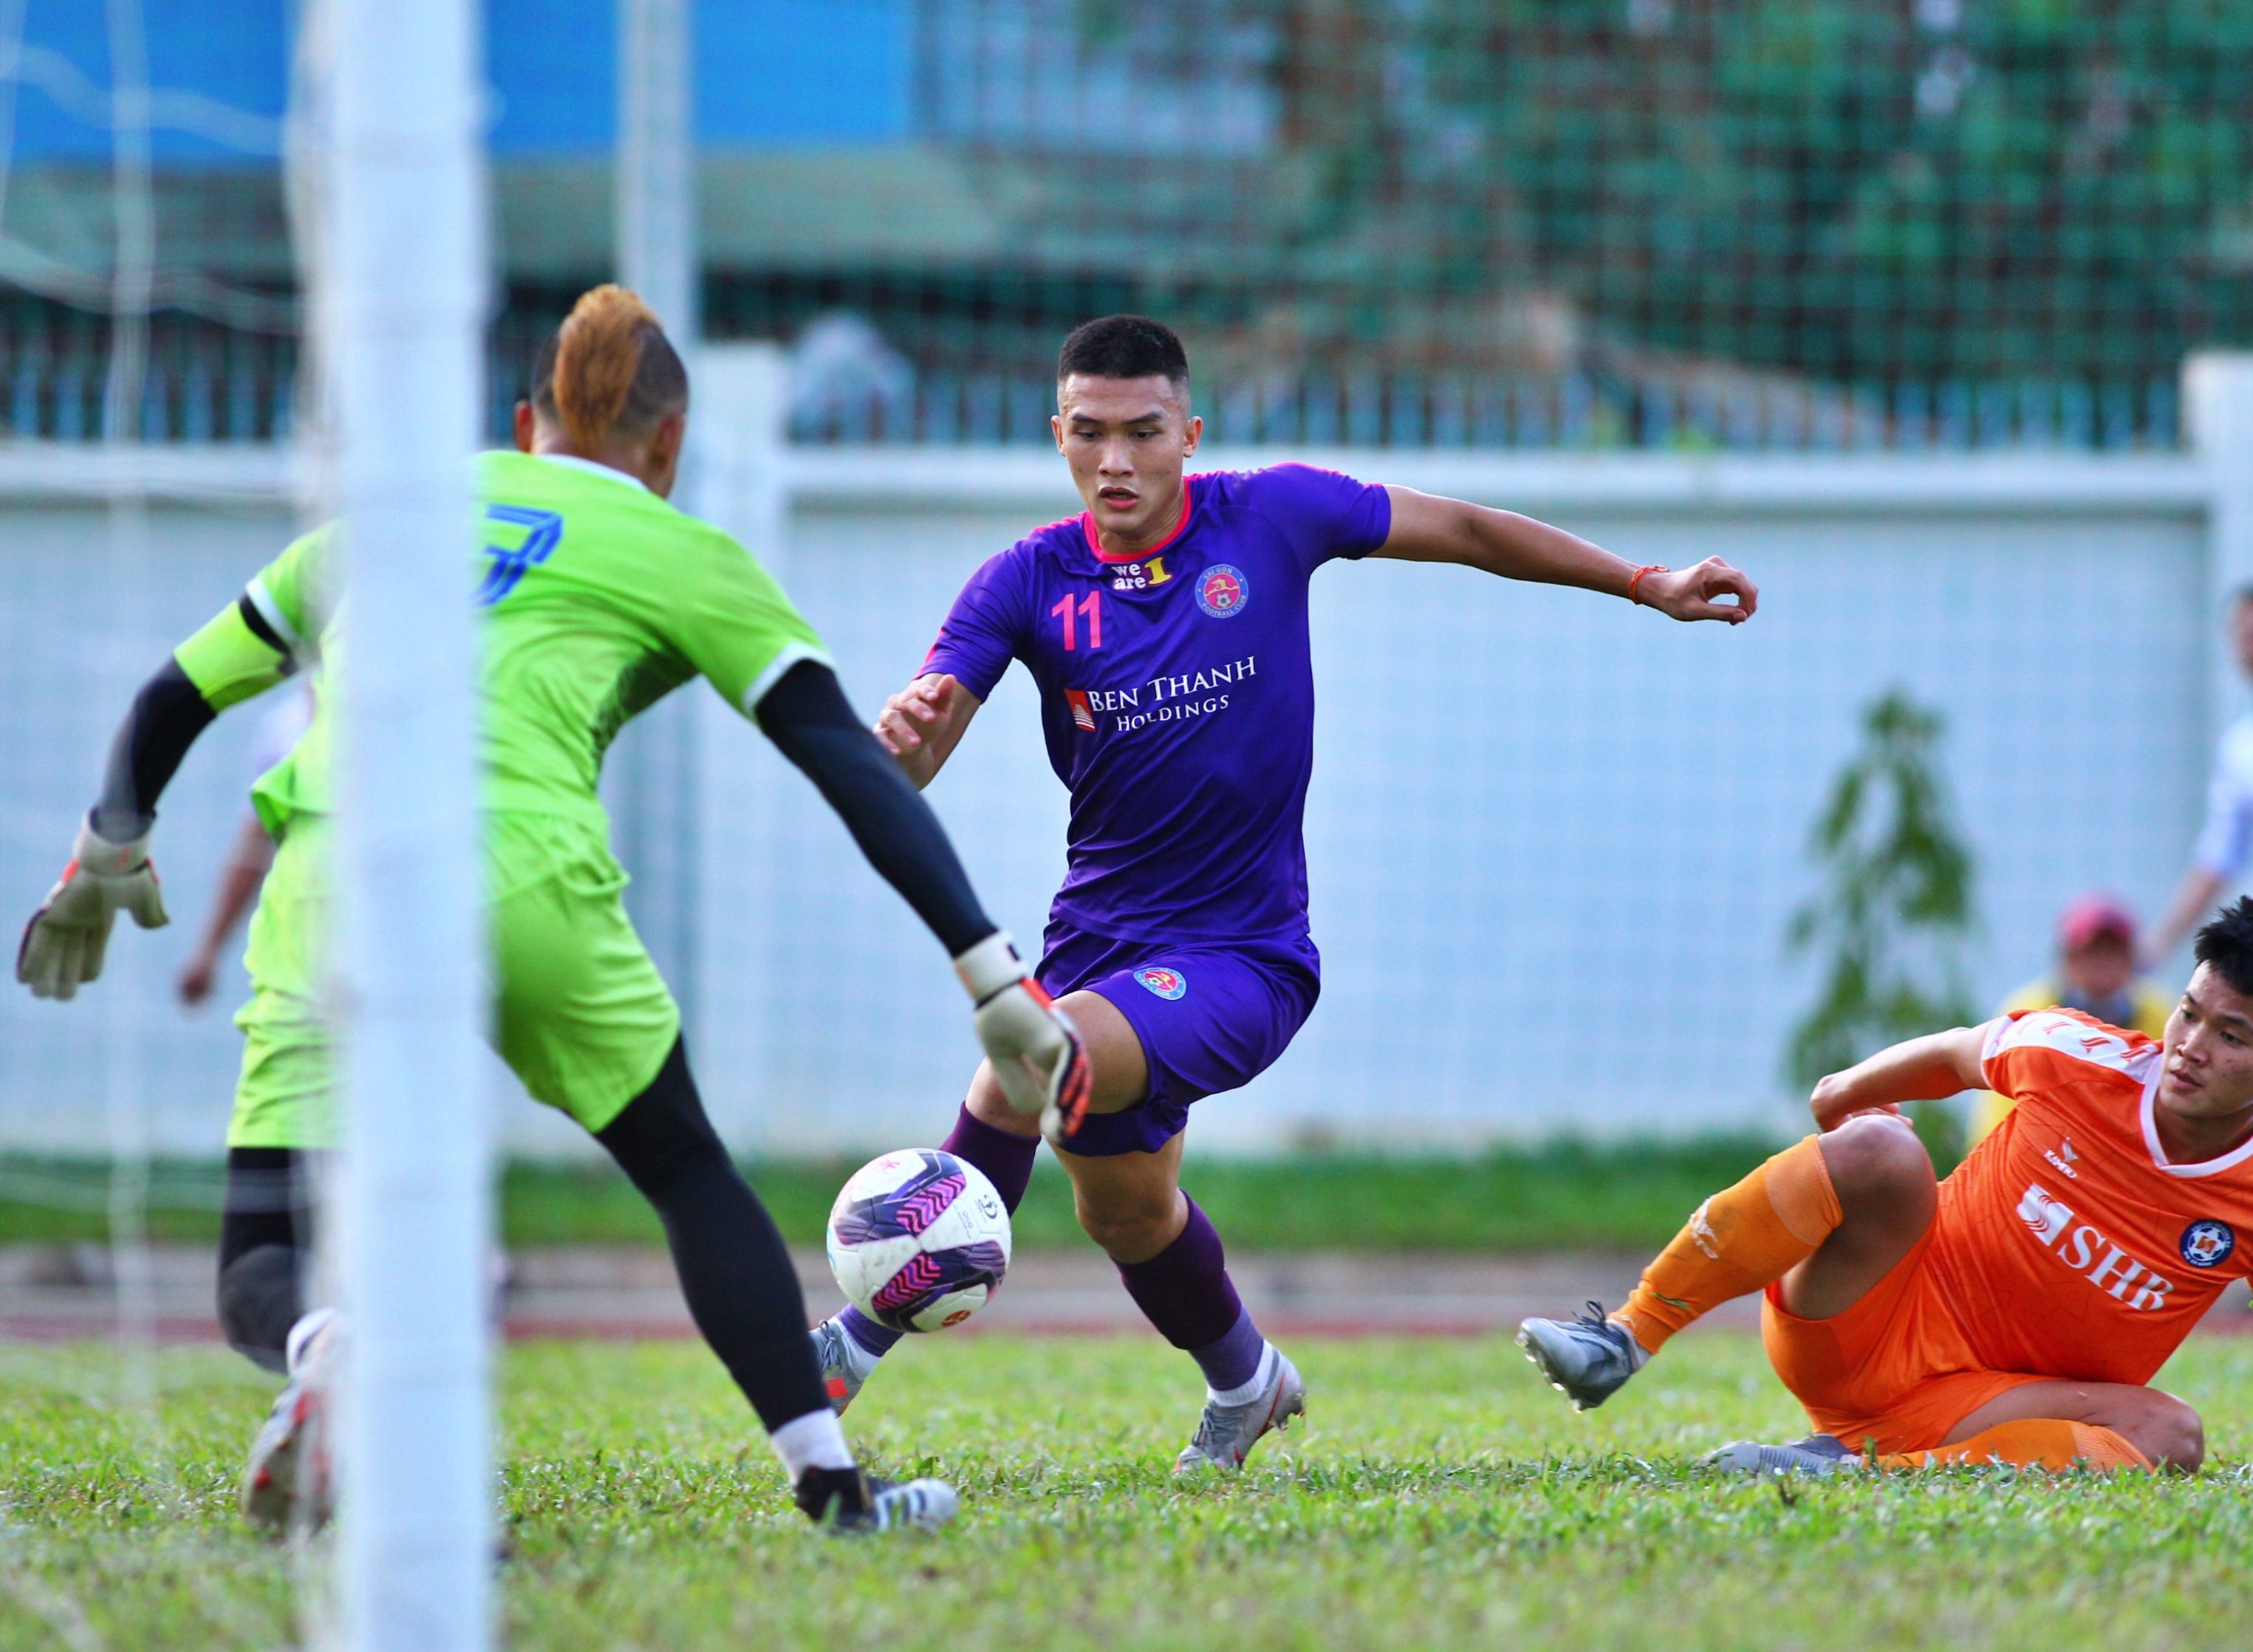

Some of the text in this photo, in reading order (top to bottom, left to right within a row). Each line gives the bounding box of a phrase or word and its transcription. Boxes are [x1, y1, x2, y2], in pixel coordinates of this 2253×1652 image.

[1111, 564, 1141, 576] we
[1114, 577, 1146, 590] are
[1144, 557, 1171, 584] 1
[1051, 590, 1101, 651] 11
[1202, 603, 1234, 617] FOOTBALL
[1087, 656, 1257, 712] BEN THANH
[1116, 695, 1229, 731] HOLDINGS
[2057, 1225, 2174, 1312] SHB
